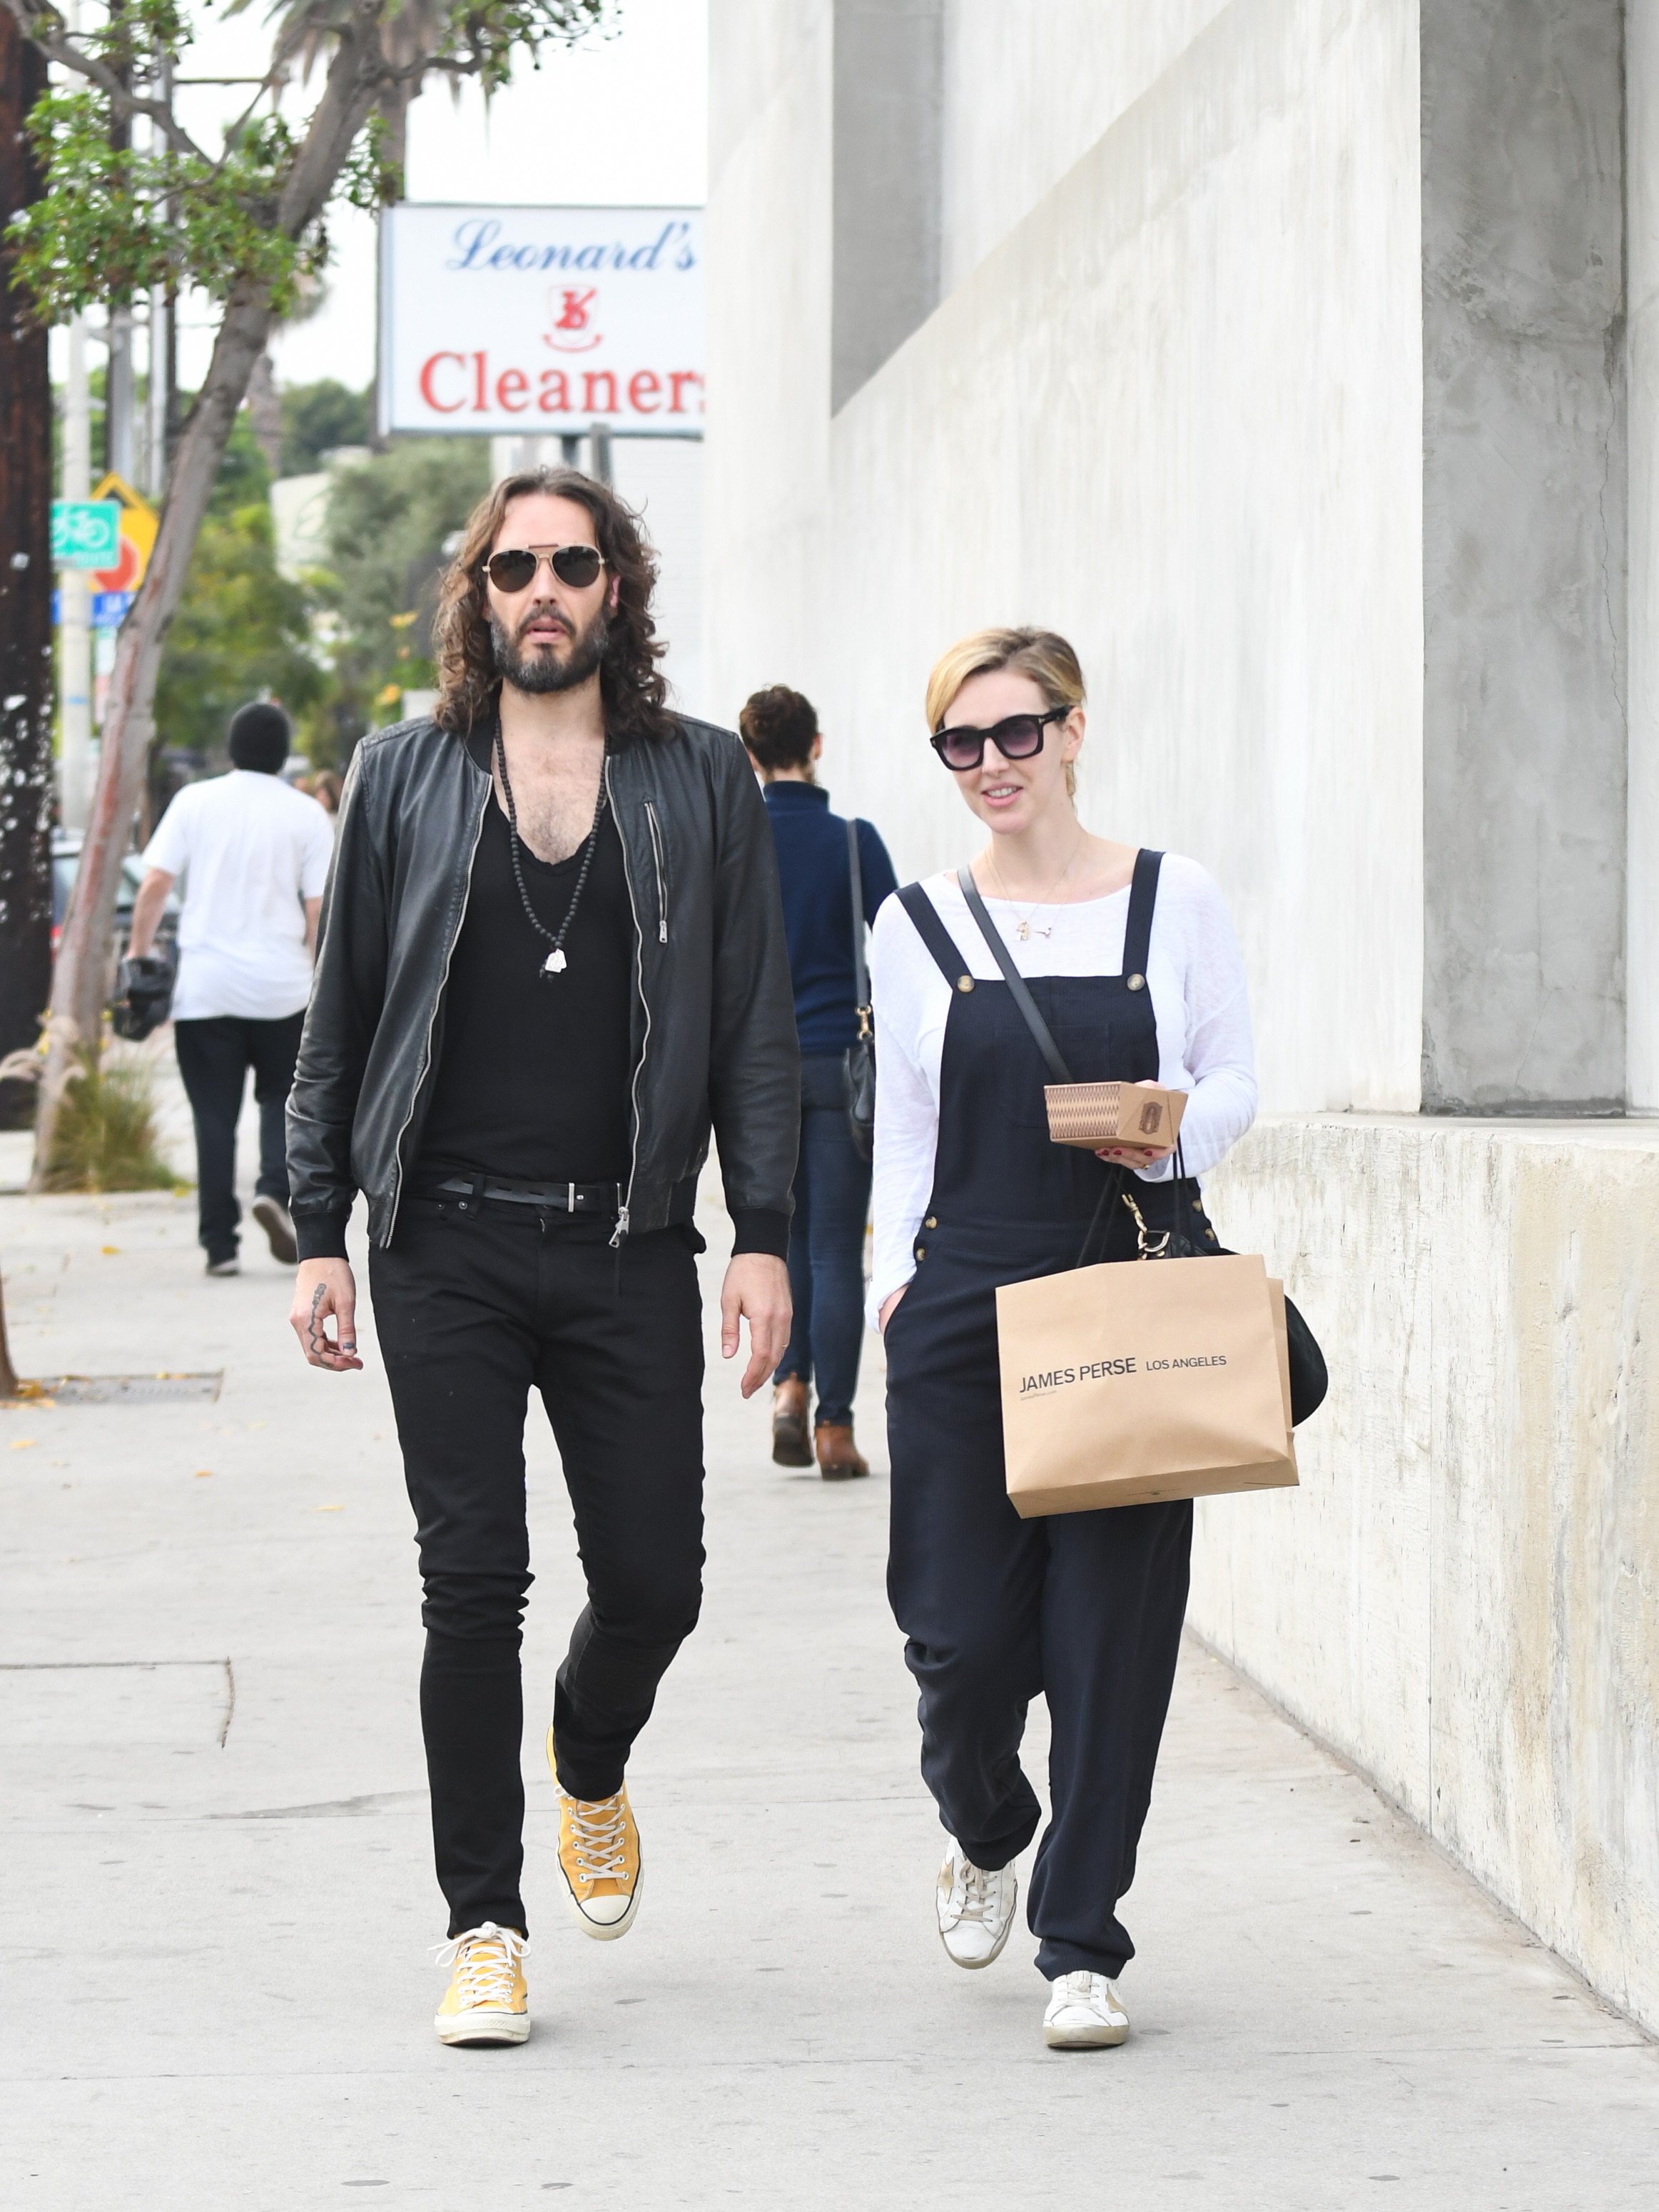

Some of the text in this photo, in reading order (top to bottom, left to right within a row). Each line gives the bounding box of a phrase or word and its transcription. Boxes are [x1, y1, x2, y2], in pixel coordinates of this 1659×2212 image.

[447, 220, 696, 271] Leonard's
[1019, 1355, 1227, 1394] JAMES PERSE LOS ANGELES
